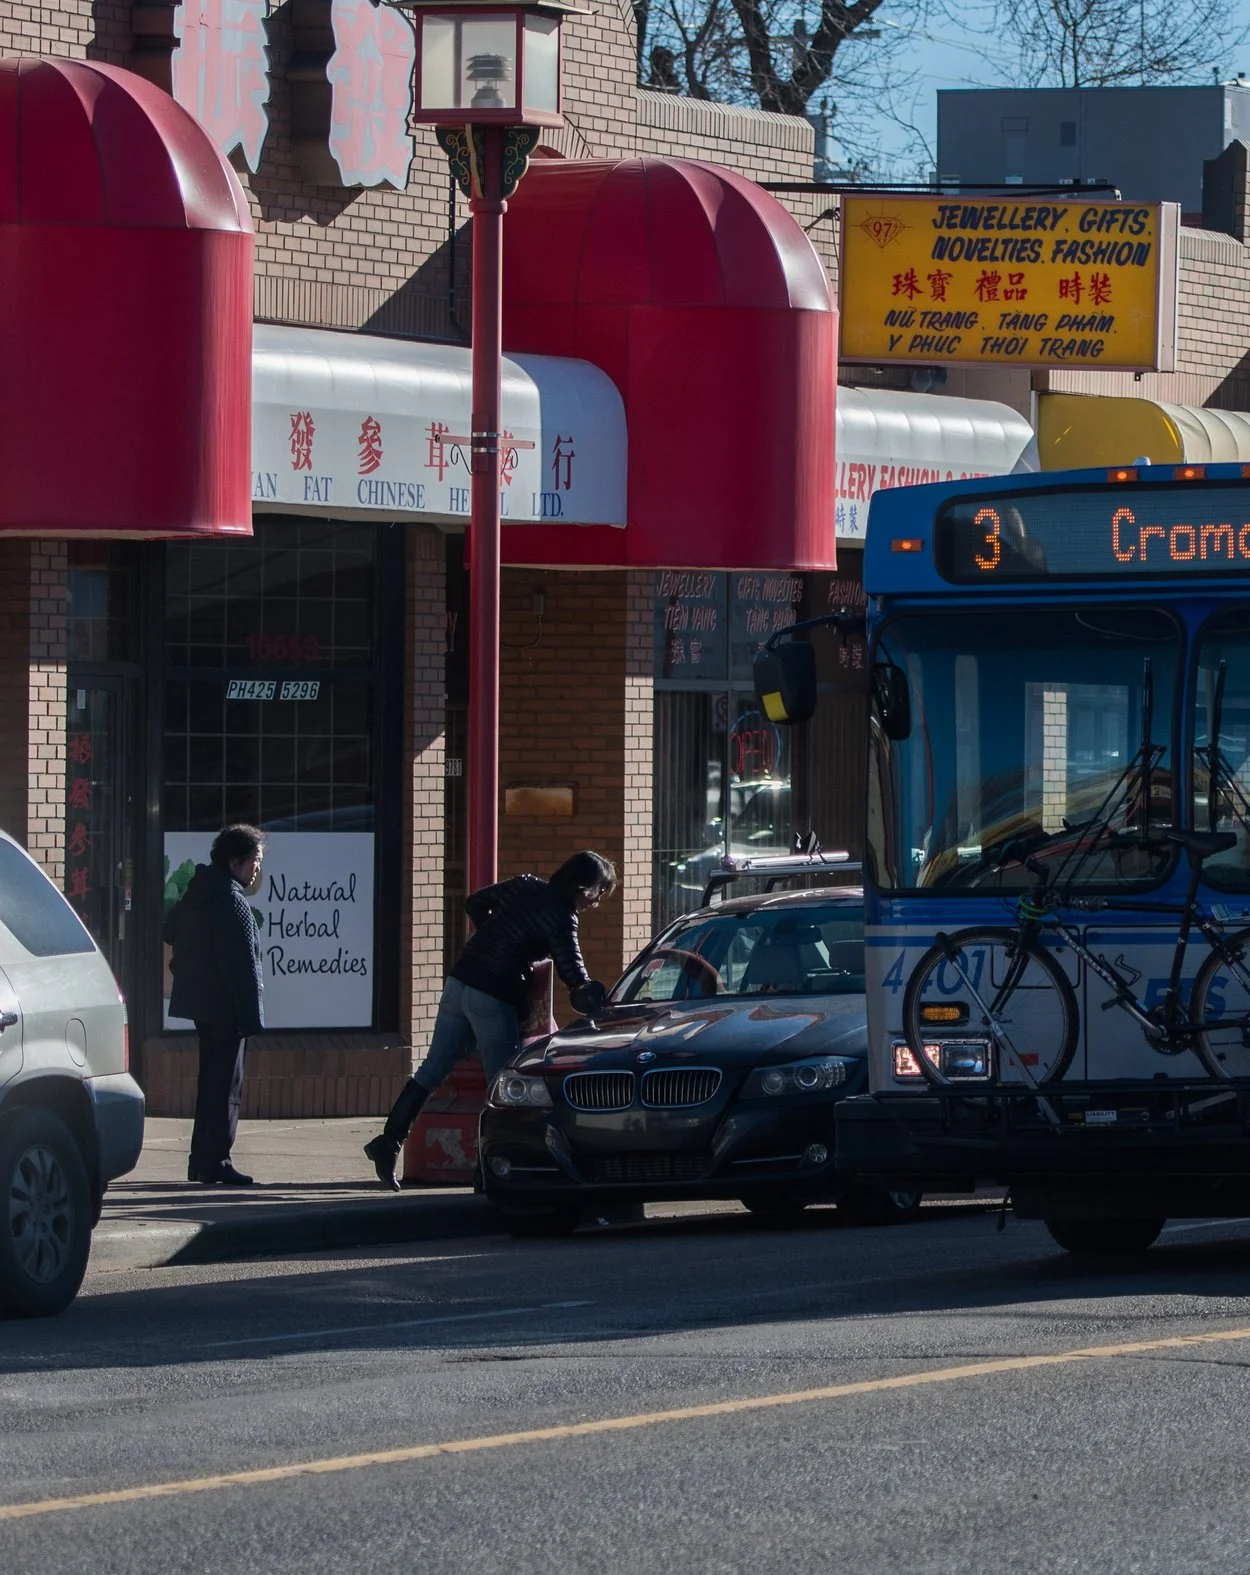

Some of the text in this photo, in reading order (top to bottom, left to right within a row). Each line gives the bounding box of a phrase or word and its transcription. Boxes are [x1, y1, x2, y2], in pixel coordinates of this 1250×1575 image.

[872, 220, 892, 238] 97
[1051, 239, 1152, 268] FASHION
[891, 267, 954, 303] 珠寶
[973, 269, 1028, 303] 禮品
[888, 334, 903, 353] Y
[1039, 338, 1104, 360] TRANG
[252, 472, 564, 517] AN FAT CHINESE HEL LTD.
[974, 508, 1001, 569] 3
[656, 571, 716, 599] JEWELLERY
[227, 681, 319, 699] PH425 5296
[268, 872, 357, 903] Natural
[268, 908, 340, 939] Herbal
[266, 945, 367, 976] Remedies
